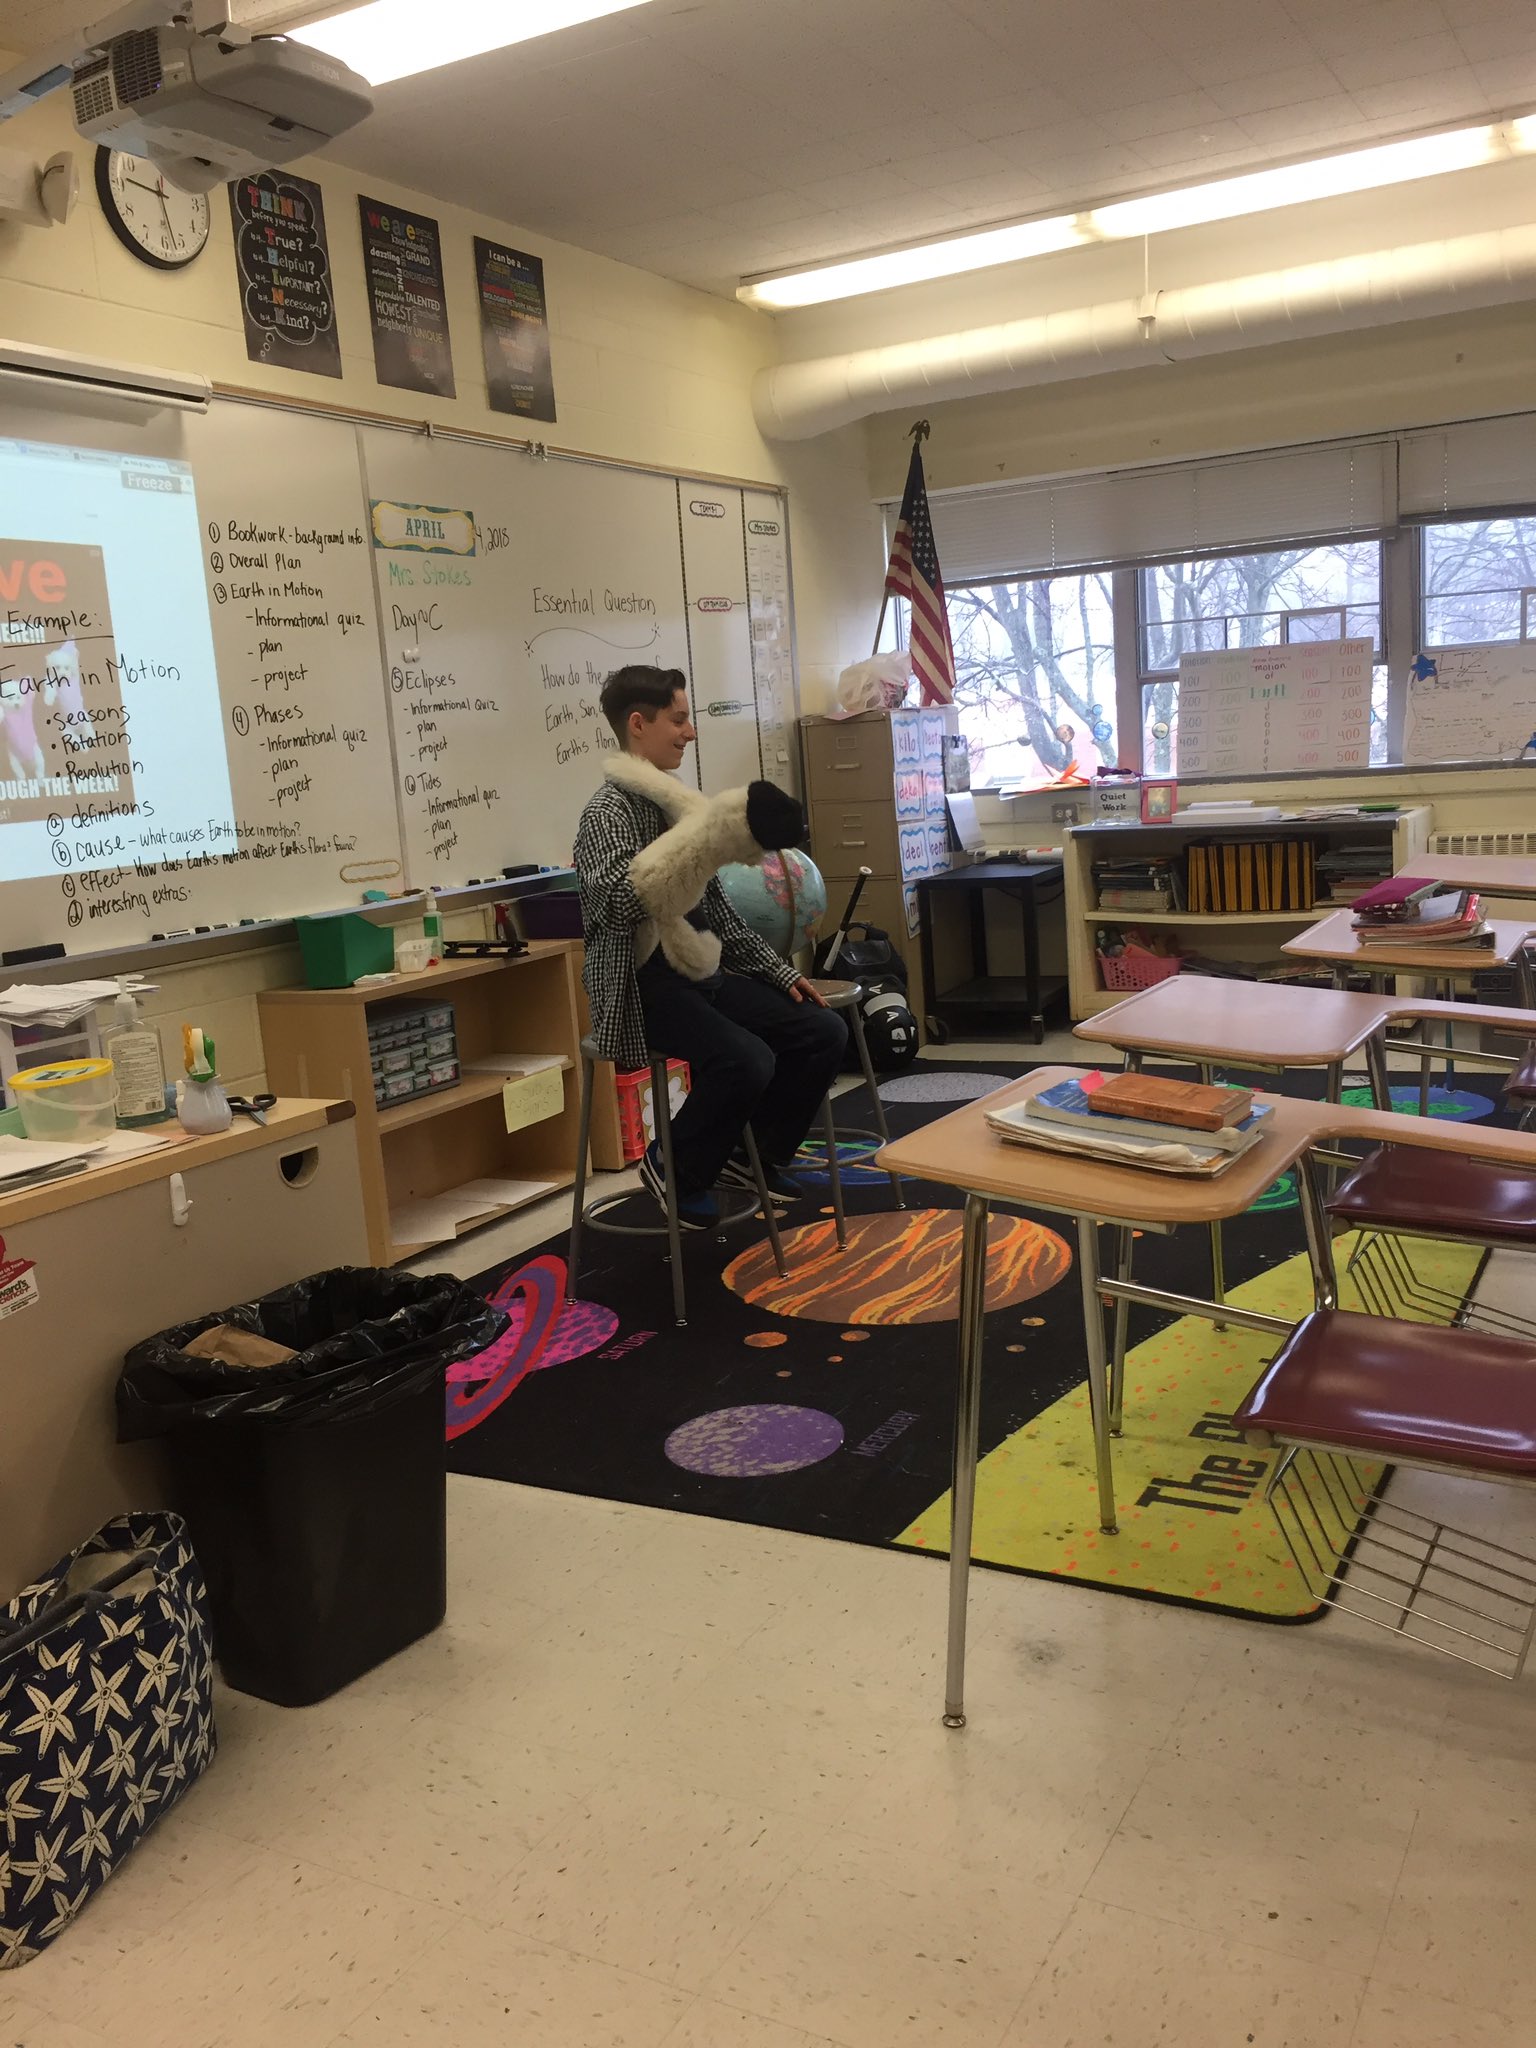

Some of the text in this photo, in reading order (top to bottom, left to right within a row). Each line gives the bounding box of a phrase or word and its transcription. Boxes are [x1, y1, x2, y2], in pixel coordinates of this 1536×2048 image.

[121, 156, 135, 172] 10
[116, 177, 125, 192] 9
[125, 203, 134, 216] 8
[191, 198, 200, 212] 3
[247, 185, 306, 222] THINK
[189, 219, 196, 233] 4
[251, 209, 273, 223] before
[142, 224, 149, 240] 7
[177, 233, 186, 248] 5
[264, 226, 303, 252] True?
[161, 236, 169, 250] 6
[267, 247, 315, 275] Helpful?
[370, 246, 400, 265] dazzling
[405, 250, 430, 266] GRAND
[493, 252, 505, 263] can
[506, 255, 515, 267] be
[396, 267, 404, 291] FINE
[272, 287, 327, 318] Necessary?
[375, 297, 412, 321] HONEST
[404, 292, 439, 311] TALENTED
[274, 307, 309, 330] Kind?
[377, 317, 412, 335] neighborly
[413, 327, 443, 343] UNIQUE
[128, 473, 173, 491] Freeze
[405, 517, 445, 539] APRIL
[229, 553, 268, 569] Overall
[423, 560, 472, 586] Stokes
[231, 582, 264, 599] Earth
[269, 584, 280, 597] in
[284, 581, 323, 599] Motion
[533, 587, 656, 615] Essential Question
[7, 610, 102, 635] Example:
[392, 603, 443, 644] Day C
[259, 638, 283, 661] plan
[0, 653, 180, 698] Earth in Motion
[264, 664, 308, 691] project
[541, 661, 603, 690] How do the
[1254, 662, 1287, 672] motion
[1265, 672, 1273, 680] of
[1341, 665, 1361, 677] 100
[405, 669, 456, 695] Eclipses
[1341, 686, 1362, 699] 200
[254, 703, 303, 726] Phases
[1342, 709, 1362, 721] 300
[417, 720, 437, 741] plan
[1338, 728, 1360, 740] 400
[62, 730, 131, 755] Rotation
[419, 736, 448, 762] project
[1337, 750, 1359, 763] 500
[66, 759, 144, 784] Revolution
[271, 758, 299, 782] plan
[44, 776, 71, 797] THE
[276, 774, 312, 808] project
[417, 772, 442, 792] Tides
[1100, 793, 1126, 802] Quiet
[1102, 803, 1127, 812] Work
[72, 800, 155, 829] definitions
[432, 819, 452, 839] plan
[76, 835, 125, 862] cause
[140, 828, 167, 848] what
[170, 827, 205, 844] causes
[208, 819, 233, 841] Earth
[433, 832, 458, 860] project
[134, 856, 157, 878] How
[87, 892, 151, 918] interesting
[597, 1329, 658, 1360] SATURN
[851, 1409, 920, 1457] MERCURY
[1135, 1454, 1268, 1514] The
